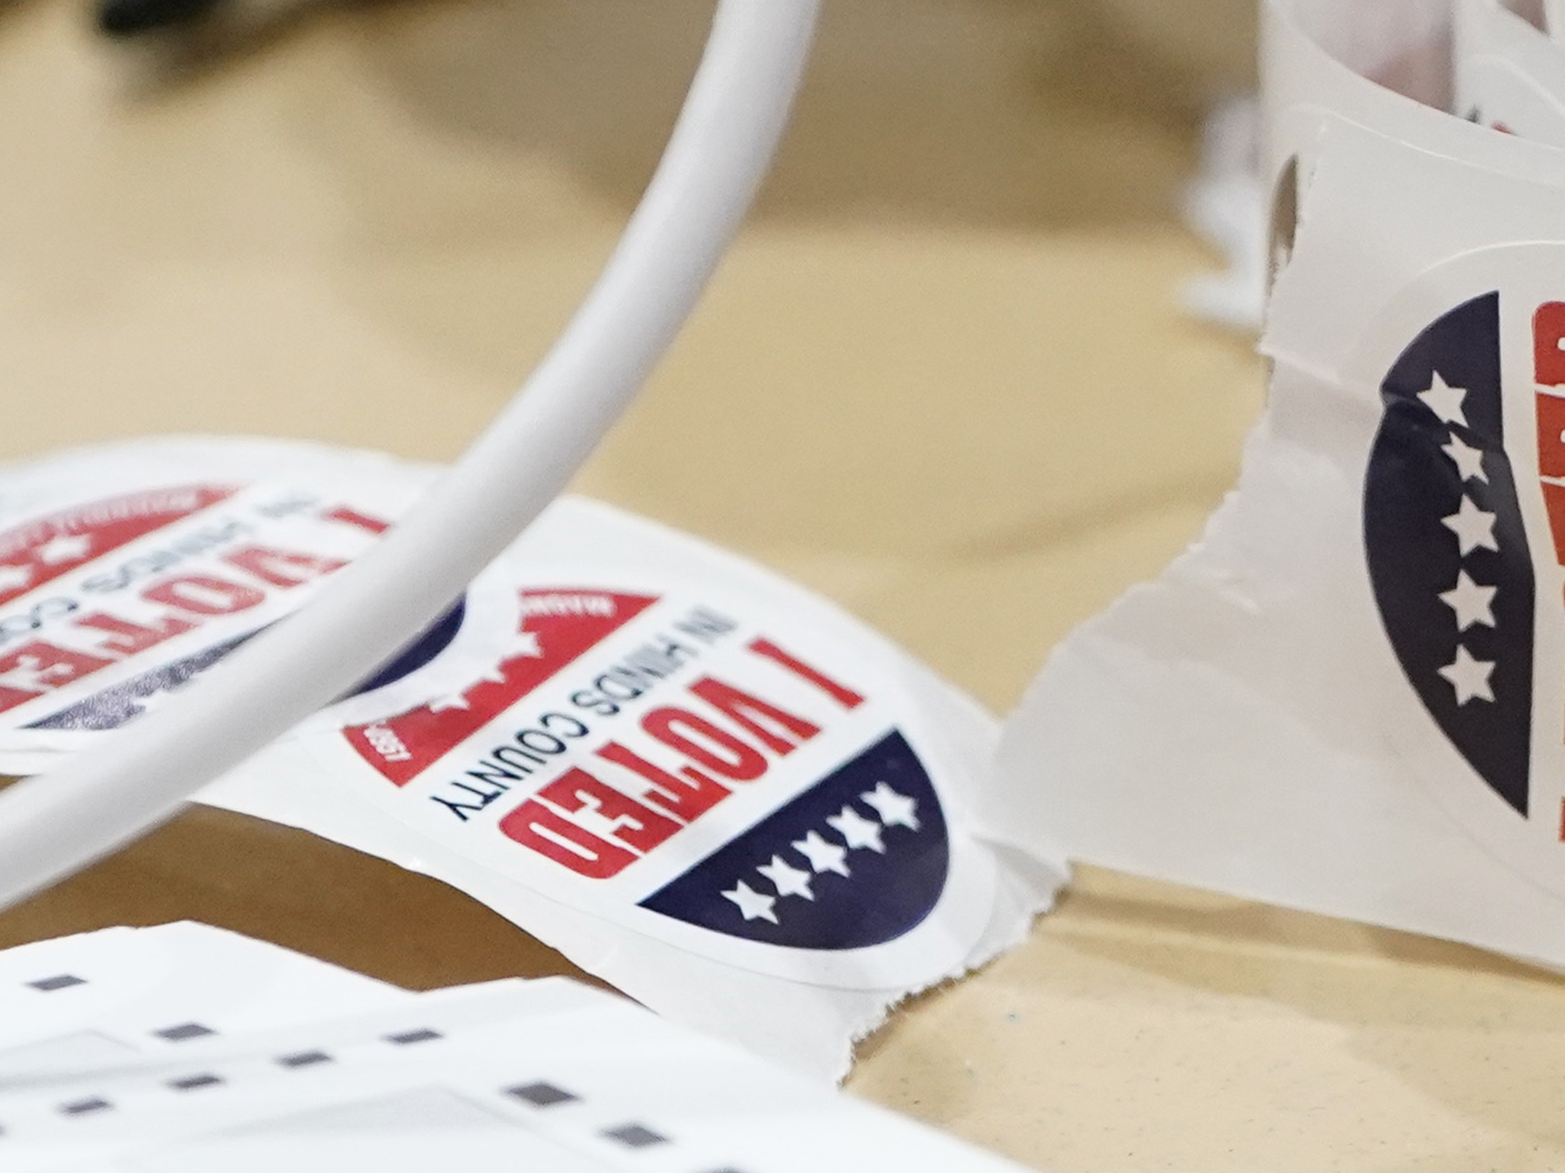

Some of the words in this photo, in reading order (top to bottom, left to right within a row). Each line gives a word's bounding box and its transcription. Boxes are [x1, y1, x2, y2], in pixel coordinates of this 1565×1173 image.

[0, 543, 352, 716] VOTE
[569, 633, 698, 716] HINDS
[746, 637, 866, 712] I
[429, 712, 589, 822] COUNTY
[499, 676, 823, 880] VOTED
